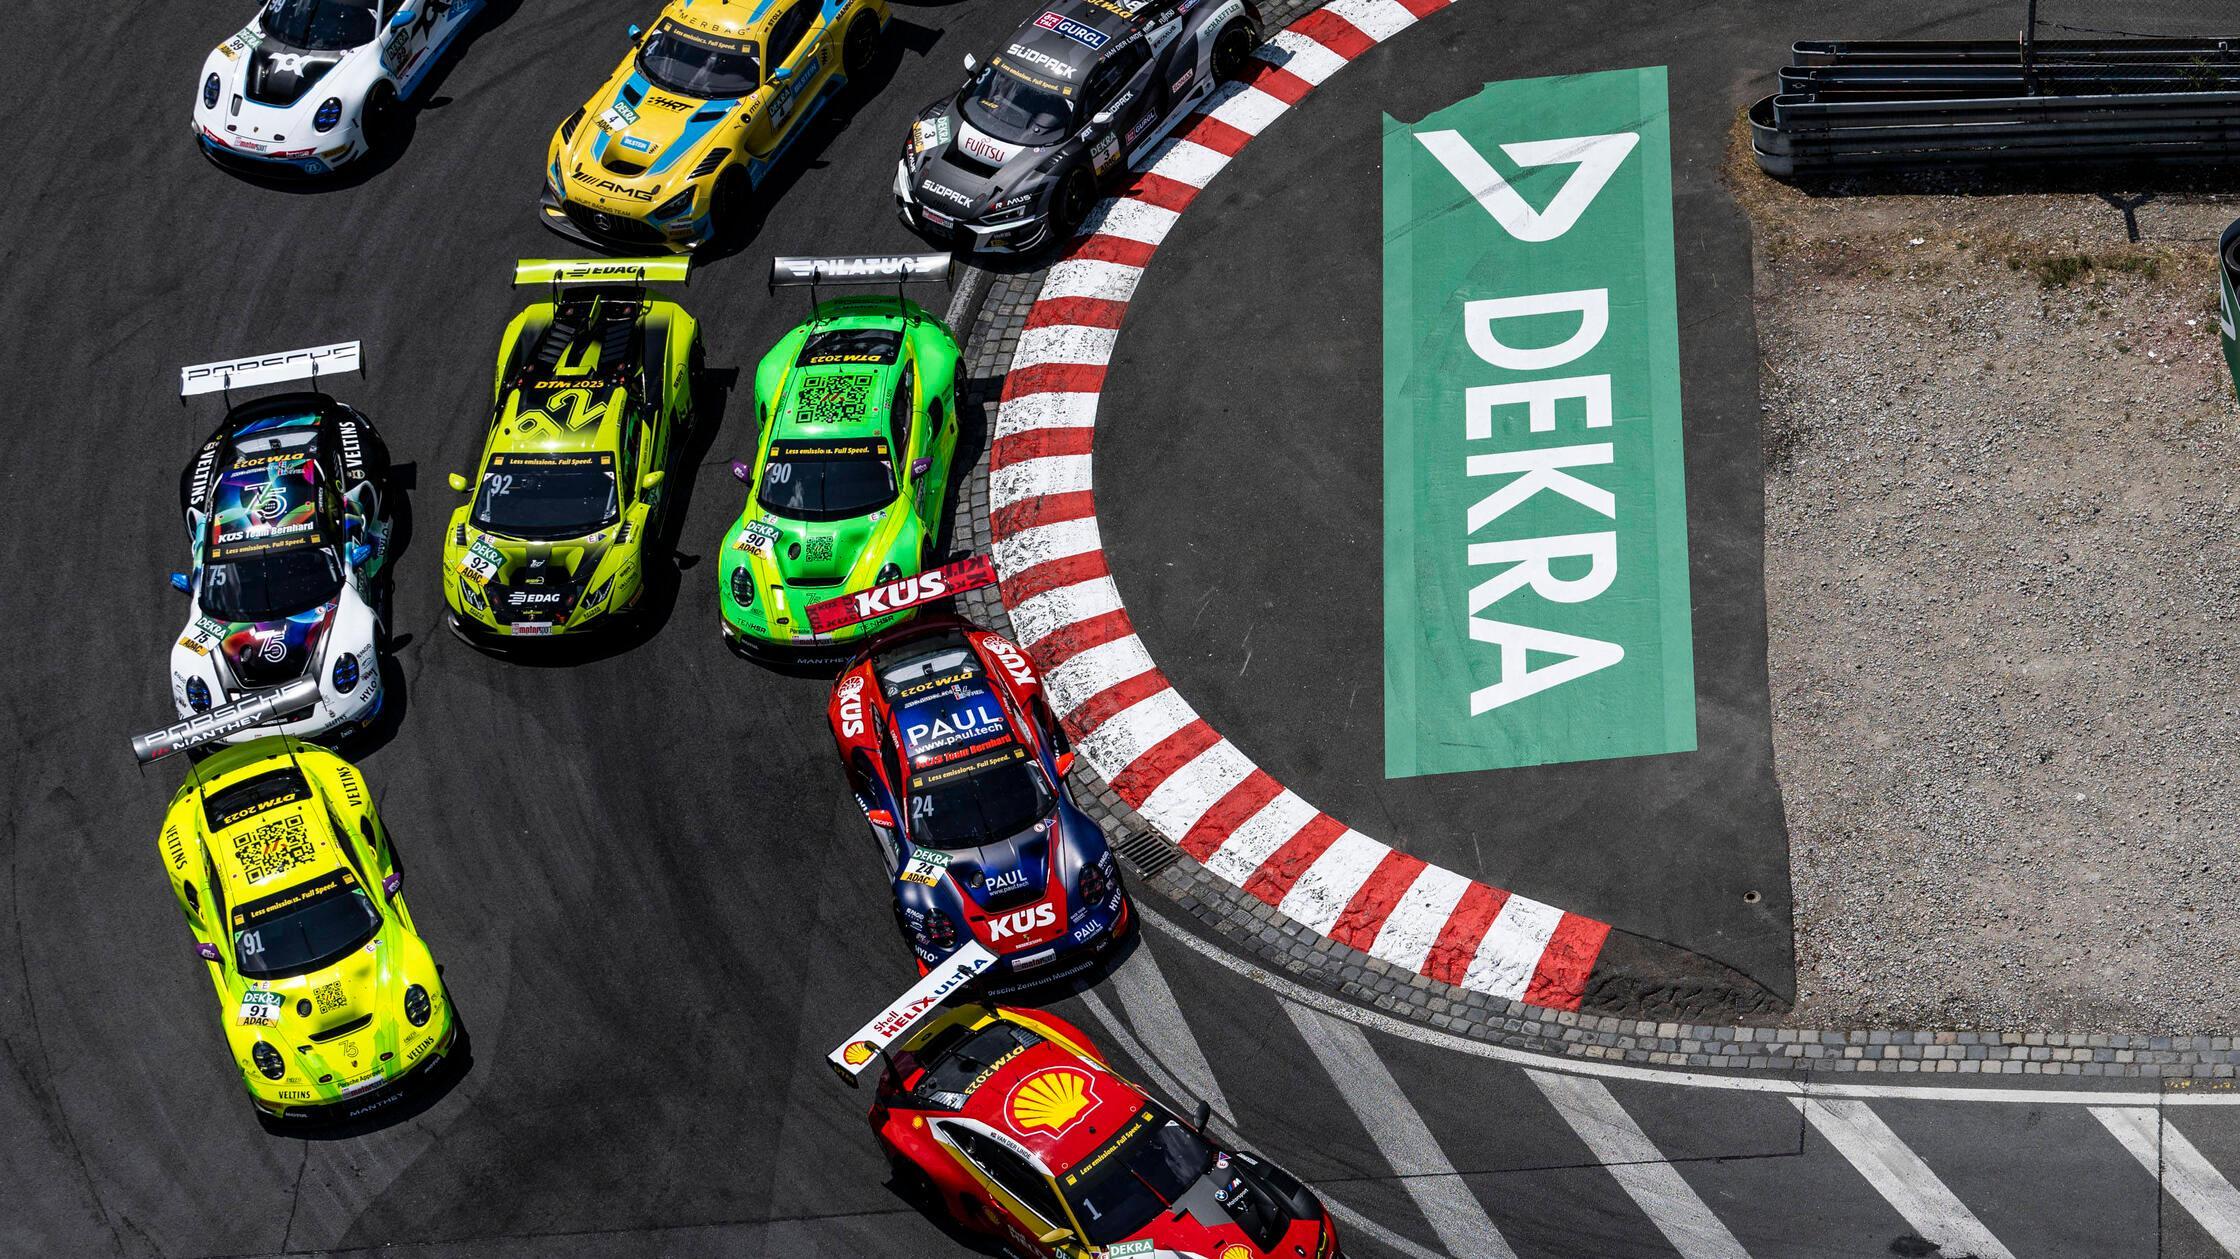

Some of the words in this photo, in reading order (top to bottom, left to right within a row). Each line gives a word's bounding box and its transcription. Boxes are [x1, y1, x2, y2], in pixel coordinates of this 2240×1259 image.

[680, 13, 746, 36] MERBAG
[768, 10, 782, 27] STOLZ
[1204, 3, 1240, 36] SCHAEFFLER
[1058, 21, 1102, 47] GURGL
[230, 39, 245, 51] 99
[646, 40, 659, 56] 4
[1105, 47, 1116, 59] VAN
[1116, 40, 1127, 51] DER
[1126, 31, 1143, 45] LINDE
[1007, 43, 1077, 79] SÜDPACK
[976, 67, 991, 84] 3
[614, 102, 638, 123] DEKRA
[769, 89, 791, 116] DEKRA
[598, 119, 613, 133] ADAC
[609, 115, 619, 123] 4
[1135, 111, 1155, 133] GURGL
[914, 127, 924, 147] ADAC
[924, 131, 936, 139] 3
[938, 117, 949, 143] DEKRA
[1081, 126, 1093, 142] ABT
[965, 137, 1005, 162] FUJITSU
[1090, 132, 1117, 157] DEKRA
[1103, 149, 1110, 160] 3
[596, 180, 653, 201] AMG
[922, 179, 974, 208] SÜDPACK
[592, 202, 613, 212] RACING
[614, 207, 630, 216] TEAM
[592, 266, 638, 275] EDAG
[810, 355, 841, 364] 2023
[843, 354, 882, 362] DTM
[534, 381, 571, 389] DTM
[572, 380, 604, 389] 2023
[339, 421, 362, 469] VELTINS
[847, 446, 870, 455] Speed.
[233, 457, 267, 469] 2023
[267, 453, 304, 464] DTM
[524, 458, 557, 466] emissions.
[571, 458, 593, 466] Speed.
[191, 450, 216, 505] VELTINS
[770, 463, 792, 484] 90
[490, 474, 513, 497] 92
[244, 481, 287, 519] 75
[1464, 287, 1625, 717] DEKRA
[246, 526, 270, 539] Team
[270, 521, 314, 535] Bernhard
[746, 533, 766, 547] 90
[748, 521, 780, 542] DEKRA
[226, 547, 238, 555] Less
[239, 544, 271, 553] emissions.
[285, 538, 306, 546] Speed.
[472, 542, 503, 568] DEKRA
[738, 542, 762, 557] ADAC
[207, 564, 227, 587] 75
[462, 566, 484, 583] ADAC
[470, 557, 490, 574] 92
[527, 593, 560, 603] EDAG
[855, 571, 946, 617] KÜS
[194, 631, 212, 643] 75
[197, 617, 226, 640] DEKRA
[790, 627, 810, 635] Porsche
[184, 639, 204, 652] ADAC
[797, 656, 850, 665] MANTHEY
[991, 643, 1037, 686] KÜS
[935, 672, 973, 686] DTM
[360, 681, 377, 702] HYLO
[900, 682, 935, 698] 2023
[144, 680, 303, 747] PORSCHE
[840, 687, 864, 738] KÜS
[173, 713, 263, 750] MANTHEY
[907, 706, 1001, 746] PAUL
[915, 722, 1003, 755] www.paul.tech
[944, 746, 970, 763] Team
[969, 734, 1012, 756] Bernhard
[928, 773, 942, 783] Less
[942, 764, 976, 780] emissions.
[976, 759, 990, 769] Full
[989, 754, 1010, 767] Speed.
[336, 766, 362, 807] VELTINS
[258, 793, 296, 807] DTM
[912, 794, 935, 819] 24
[223, 806, 256, 824] 2023
[166, 824, 188, 870] VELTINS
[914, 849, 946, 867] DEKRA
[915, 862, 934, 875] 24
[906, 872, 931, 885] ADAC
[985, 869, 1027, 891] PAUL
[989, 881, 1030, 896] www.paul.tech
[251, 908, 266, 918] Less
[301, 888, 315, 900] Full
[315, 881, 337, 895] Speed.
[988, 902, 1056, 942] KÜS
[1074, 919, 1101, 942] PAUL
[243, 930, 265, 955] 91
[915, 944, 935, 962] HYLO
[1052, 960, 1094, 981] Mannheim
[244, 992, 280, 1006] DEKRA
[881, 996, 937, 1038] HELIX
[934, 959, 988, 996] ULTA
[243, 1017, 269, 1027] ADAC
[249, 1005, 269, 1018] 91
[874, 1011, 899, 1032] Shell
[338, 1040, 359, 1058] 75
[407, 1035, 435, 1060] VELTINS
[991, 1045, 1026, 1072] DTM
[337, 1078, 360, 1088] Porsche
[360, 1068, 385, 1081] Approved
[964, 1068, 994, 1095] 2023
[278, 1091, 311, 1099] VELTINS
[350, 1090, 404, 1117] MANTHEY
[996, 1134, 1007, 1145] VAN
[1006, 1139, 1018, 1151] DER
[1017, 1145, 1032, 1160] LINDE
[1080, 1164, 1093, 1175] Less
[1091, 1145, 1119, 1167] emissions.
[1116, 1134, 1128, 1146] Full
[1126, 1122, 1143, 1138] Speed.
[1083, 1198, 1102, 1221] 1
[1111, 1241, 1152, 1256] DEKRA
